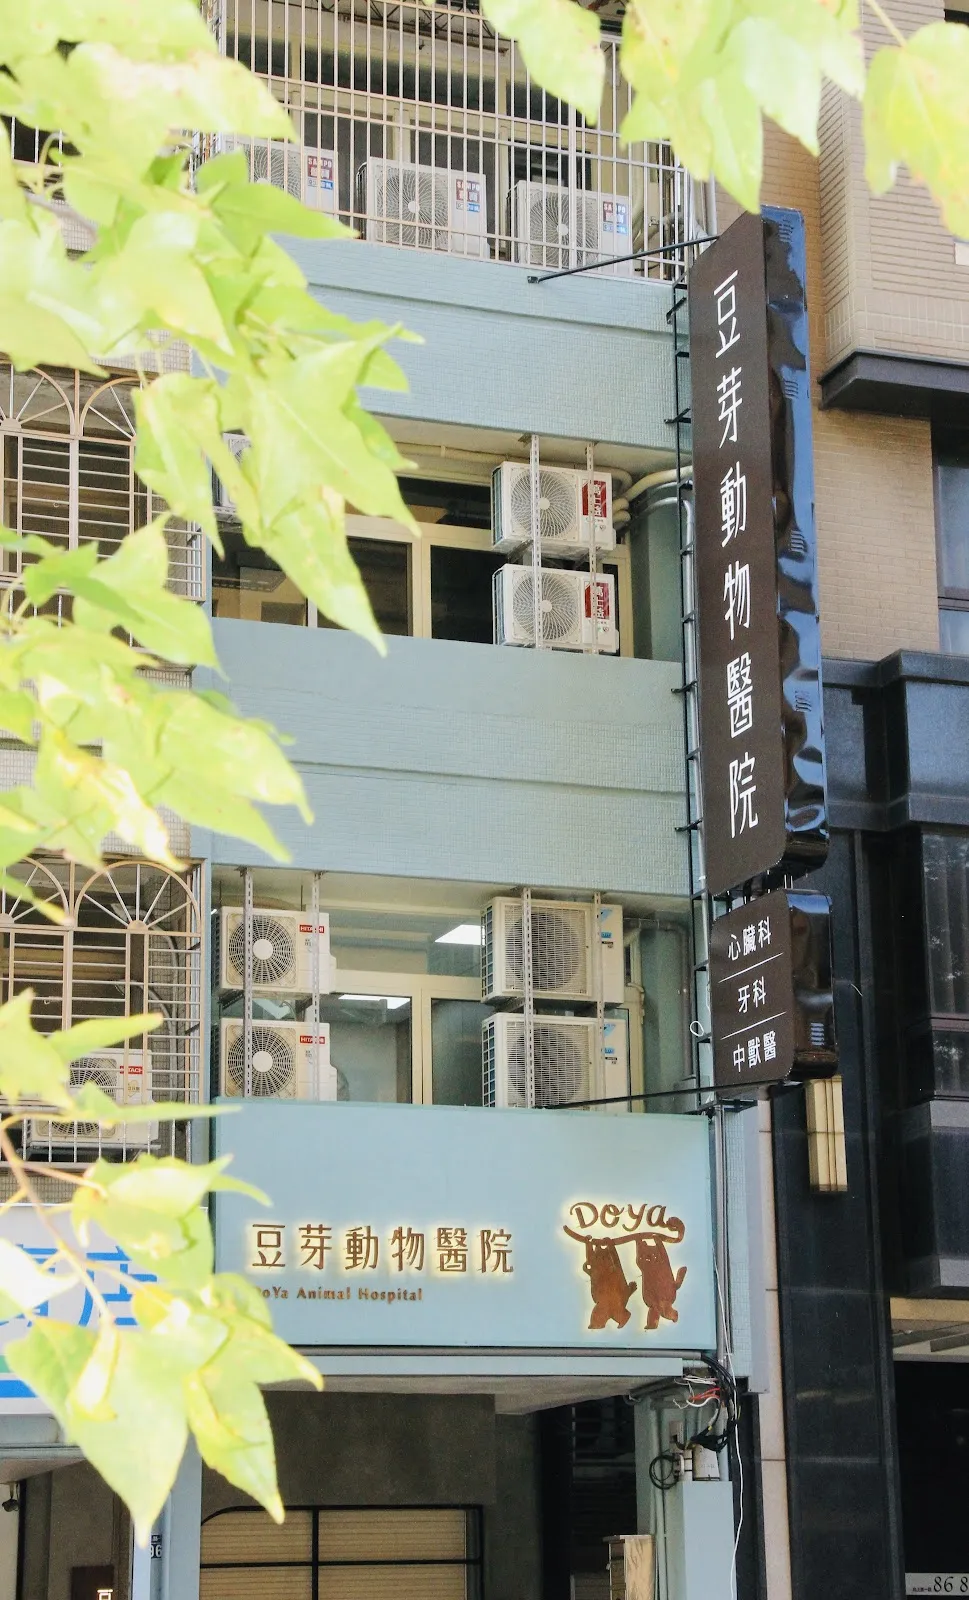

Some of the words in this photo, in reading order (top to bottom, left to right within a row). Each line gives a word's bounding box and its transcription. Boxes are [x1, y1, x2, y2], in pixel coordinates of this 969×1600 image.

[308, 157, 332, 168] SAPO
[603, 203, 626, 213] SAPO
[714, 270, 759, 839] 豆芽動物醫院
[728, 916, 772, 961] 心臟科
[738, 976, 767, 1013] 牙科
[733, 1030, 776, 1073] 中獸醫
[252, 1223, 514, 1273] 豆芽動物醫院
[296, 1286, 350, 1300] Animal
[358, 1286, 423, 1304] Hospital
[933, 1576, 954, 1593] 86
